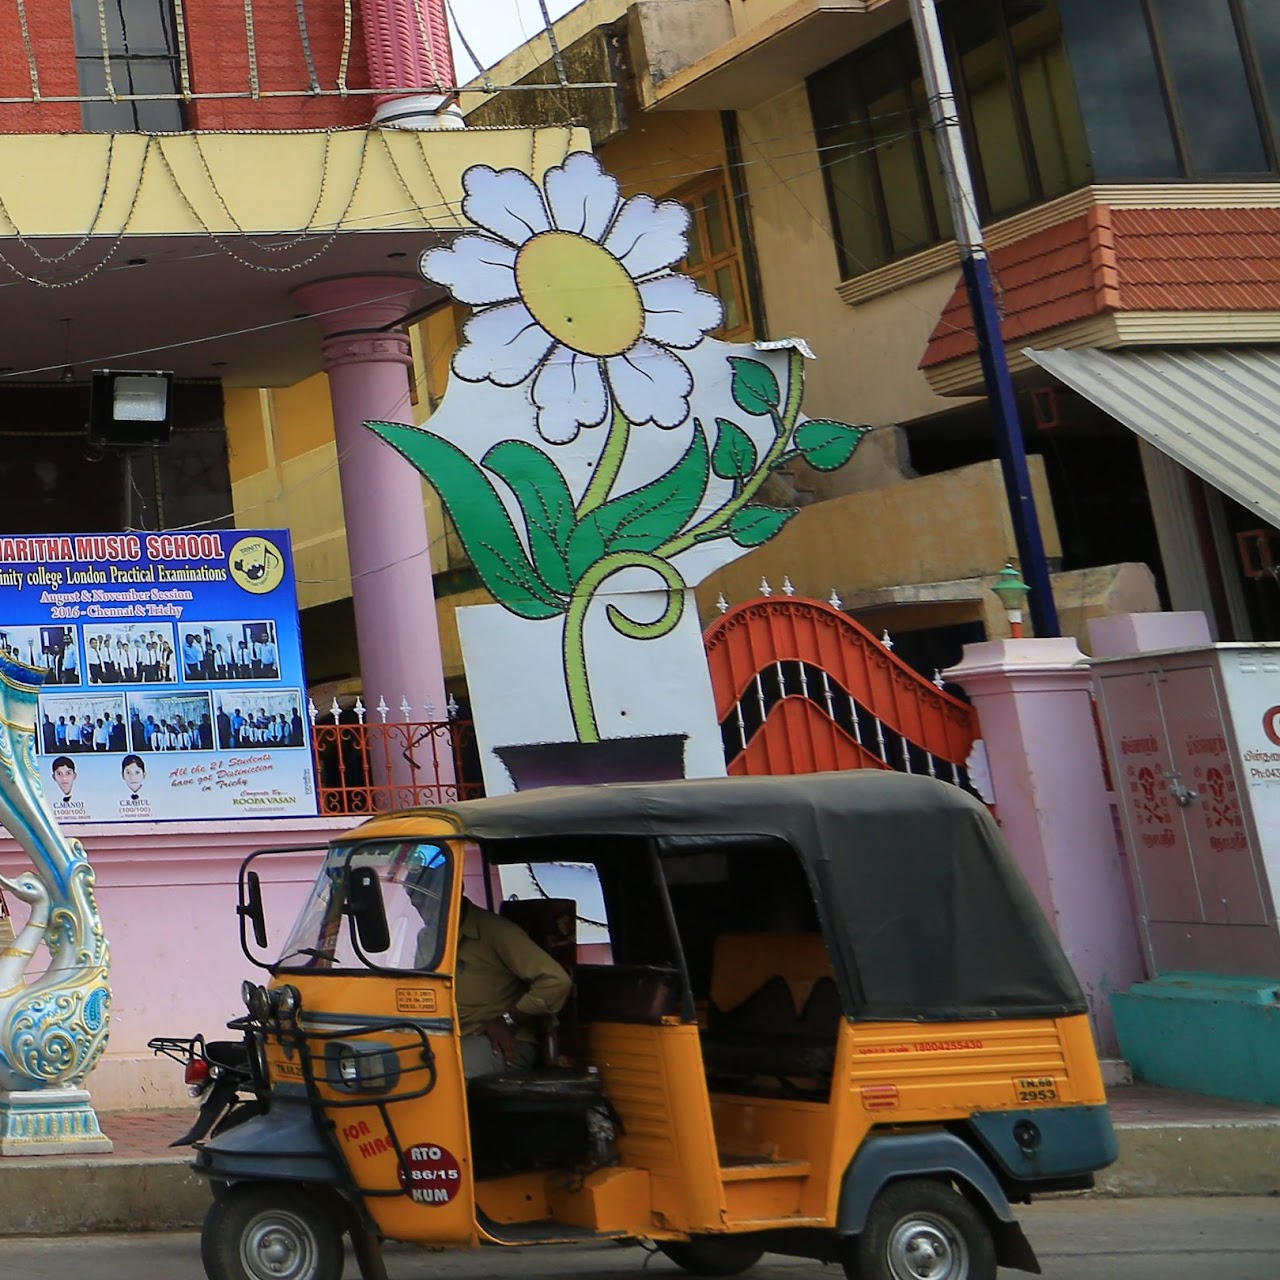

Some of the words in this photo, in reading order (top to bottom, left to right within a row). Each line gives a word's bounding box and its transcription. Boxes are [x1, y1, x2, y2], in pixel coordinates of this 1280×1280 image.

[76, 536, 140, 561] MUSIC
[146, 535, 224, 560] SCHOOL
[27, 568, 62, 590] college
[66, 567, 106, 584] London
[110, 566, 154, 583] Practical
[158, 565, 227, 582] Examinations
[40, 591, 79, 605] August
[81, 591, 91, 602] &
[92, 590, 149, 602] November
[151, 589, 193, 600] Session
[51, 607, 80, 618] 2016
[87, 605, 133, 617] Chennai
[135, 606, 146, 616] &
[146, 604, 183, 618] Trichy
[169, 768, 187, 778] All
[191, 765, 205, 774] the
[210, 761, 223, 770] 21
[228, 754, 271, 767] Students
[171, 778, 193, 787] have
[197, 774, 212, 785] got
[216, 778, 248, 789] Trichy
[53, 801, 84, 809] C.MANOJ
[120, 799, 150, 807] C.RAHUL
[267, 796, 296, 804] VASAN
[1020, 1089, 1056, 1101] 2953
[343, 1120, 370, 1141] FOR
[411, 1147, 441, 1160] RTO
[412, 1189, 449, 1201] KUM
